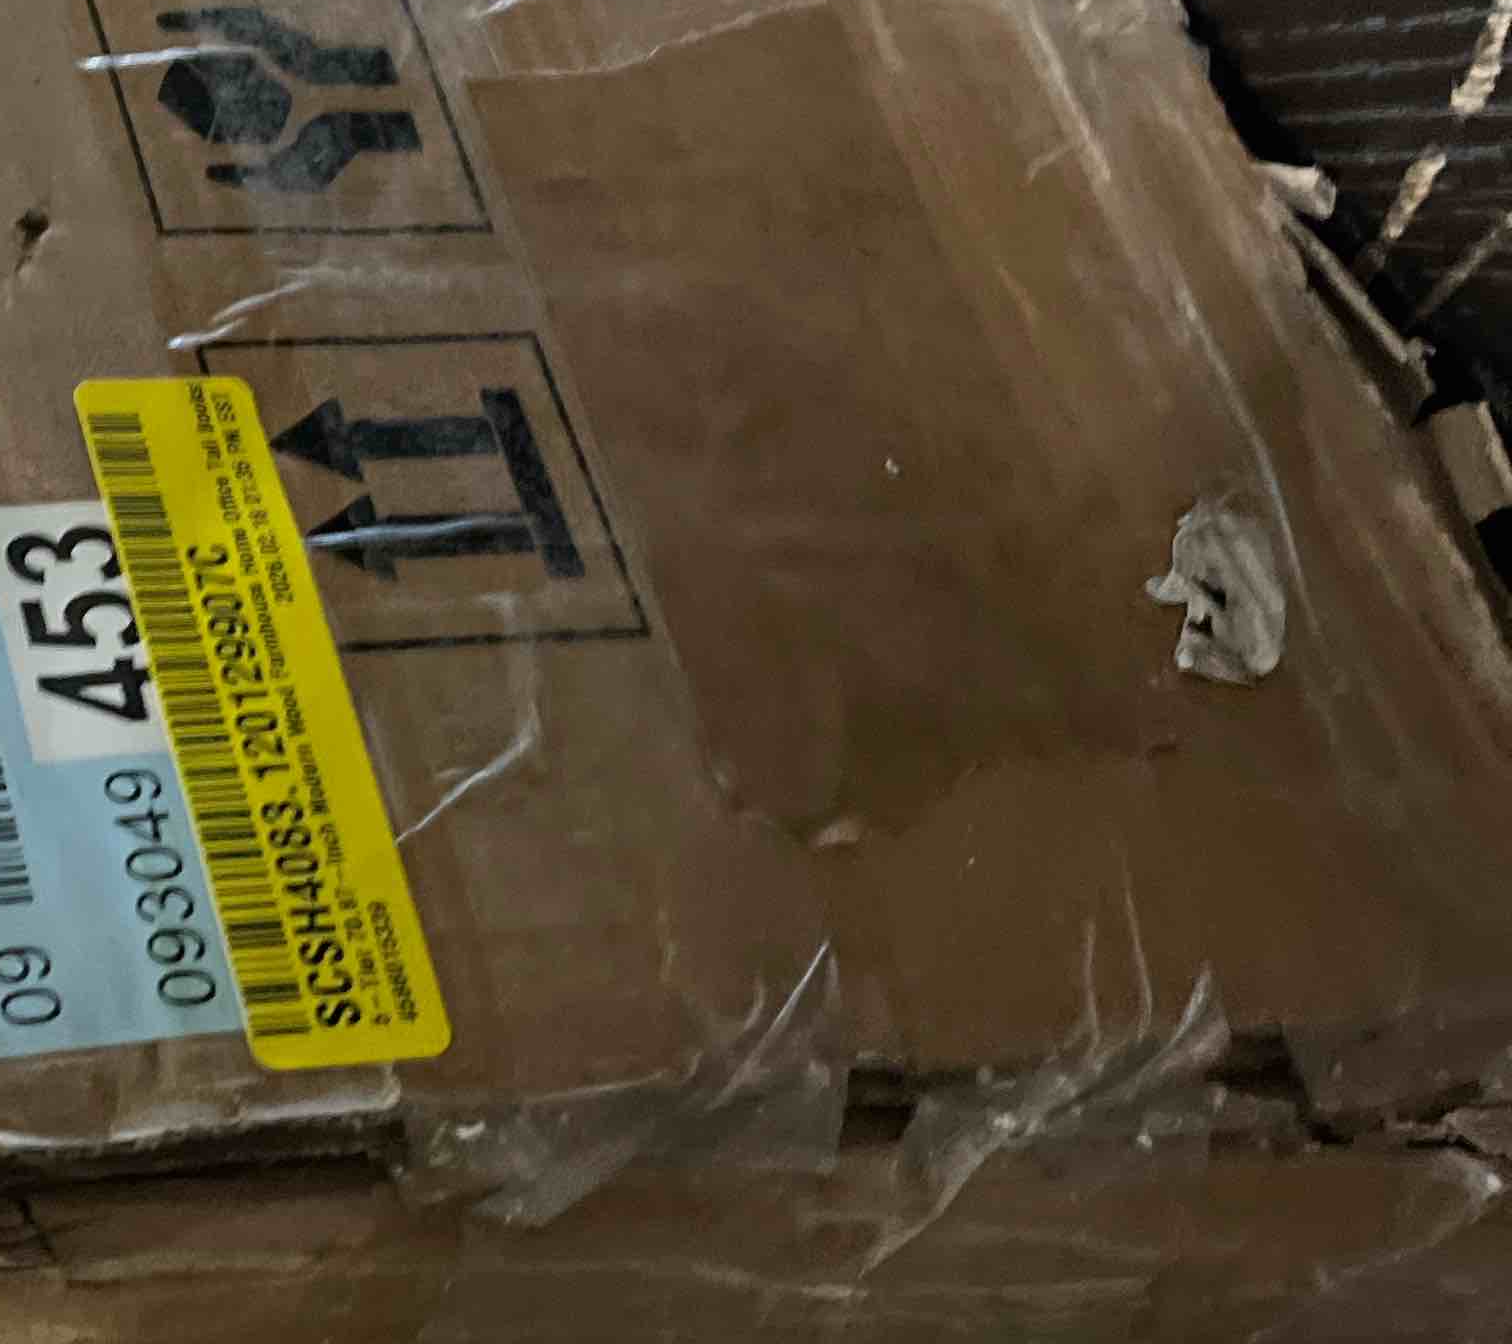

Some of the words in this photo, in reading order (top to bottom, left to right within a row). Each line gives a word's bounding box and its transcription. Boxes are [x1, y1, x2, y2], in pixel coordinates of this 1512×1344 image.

[201, 438, 224, 472] Tall
[216, 475, 241, 524] Office
[233, 527, 259, 577] Home
[5, 525, 152, 721] 453
[249, 582, 287, 681] Farmhouse
[277, 682, 306, 738] Wood
[297, 742, 329, 816] Modern
[104, 768, 216, 1007] 093049
